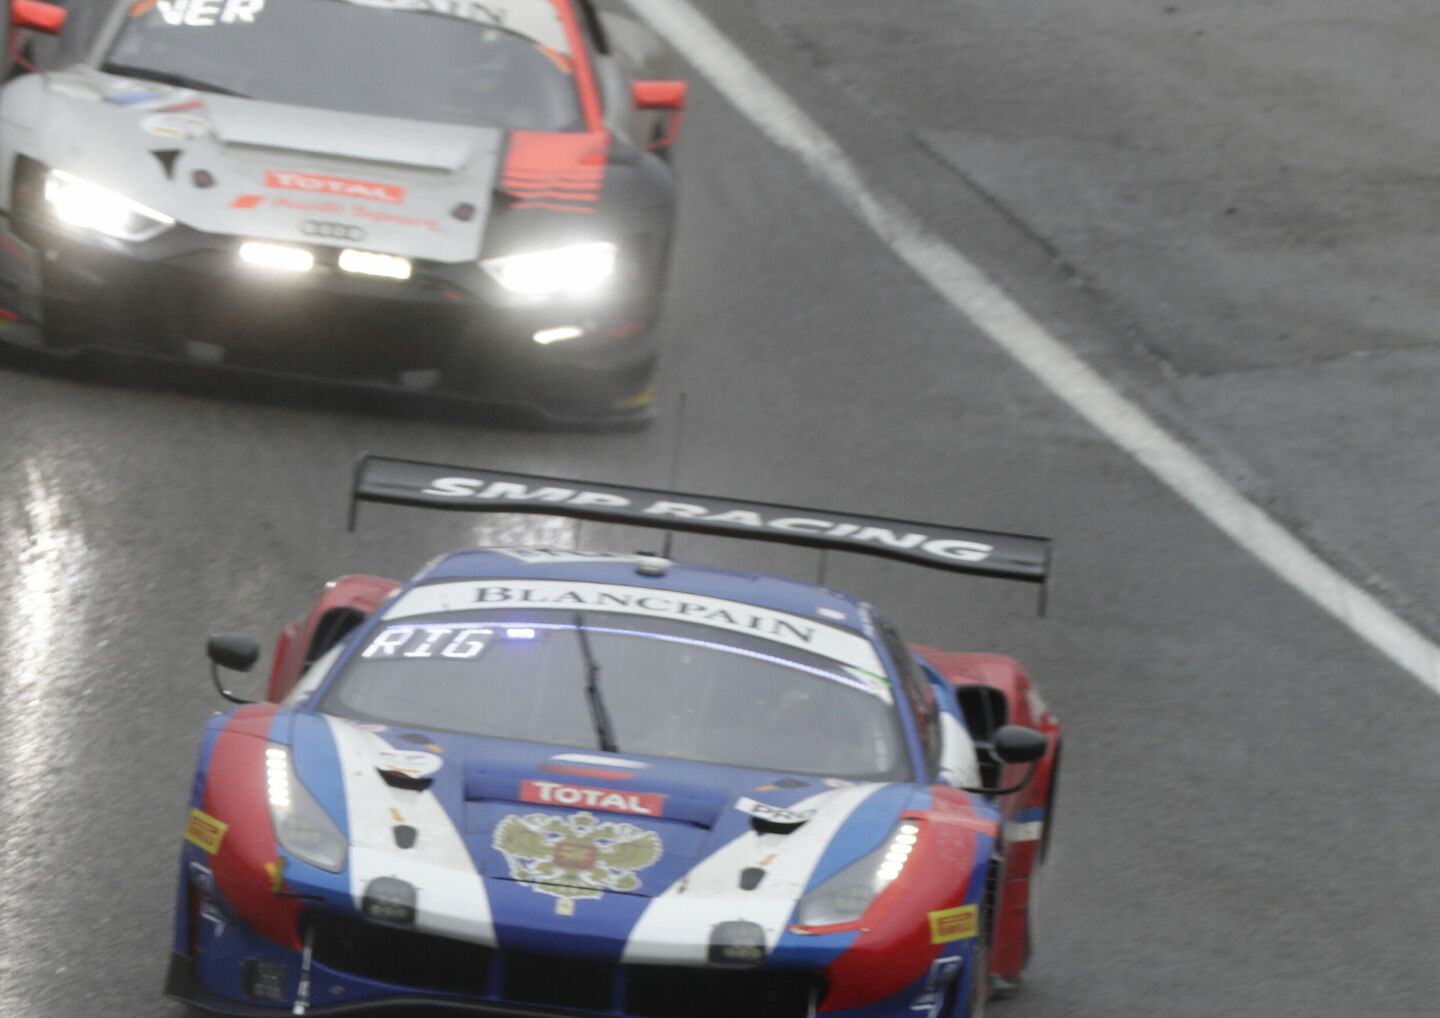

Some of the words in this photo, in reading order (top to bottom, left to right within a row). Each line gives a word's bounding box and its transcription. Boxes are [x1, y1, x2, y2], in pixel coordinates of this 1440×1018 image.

[274, 172, 399, 202] TOTAL
[421, 477, 631, 507] SMP
[642, 500, 994, 562] RACING
[474, 587, 815, 642] BLANCPAIN
[361, 627, 493, 658] RIG
[533, 781, 651, 814] TOTAL
